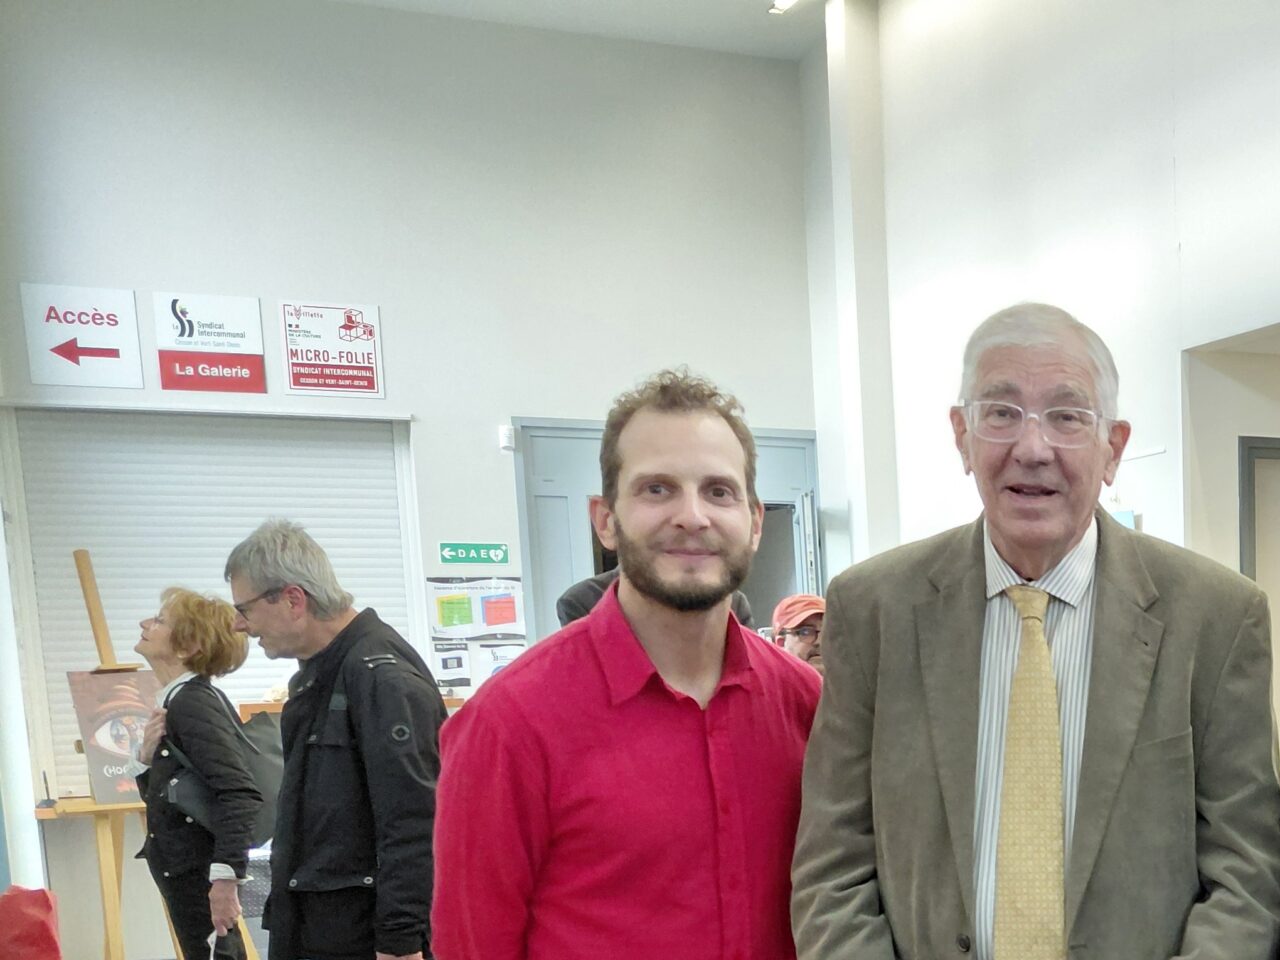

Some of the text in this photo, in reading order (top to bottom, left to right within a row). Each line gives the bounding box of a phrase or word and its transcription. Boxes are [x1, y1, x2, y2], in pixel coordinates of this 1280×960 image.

[44, 305, 119, 327] Accès
[197, 320, 225, 330] Syndicat
[197, 330, 246, 339] Intercommunal
[290, 348, 374, 365] MICRO-FOLIE
[175, 362, 251, 378] La Galerie
[292, 366, 374, 377] SYNDICAT INTERCOMMUNAL
